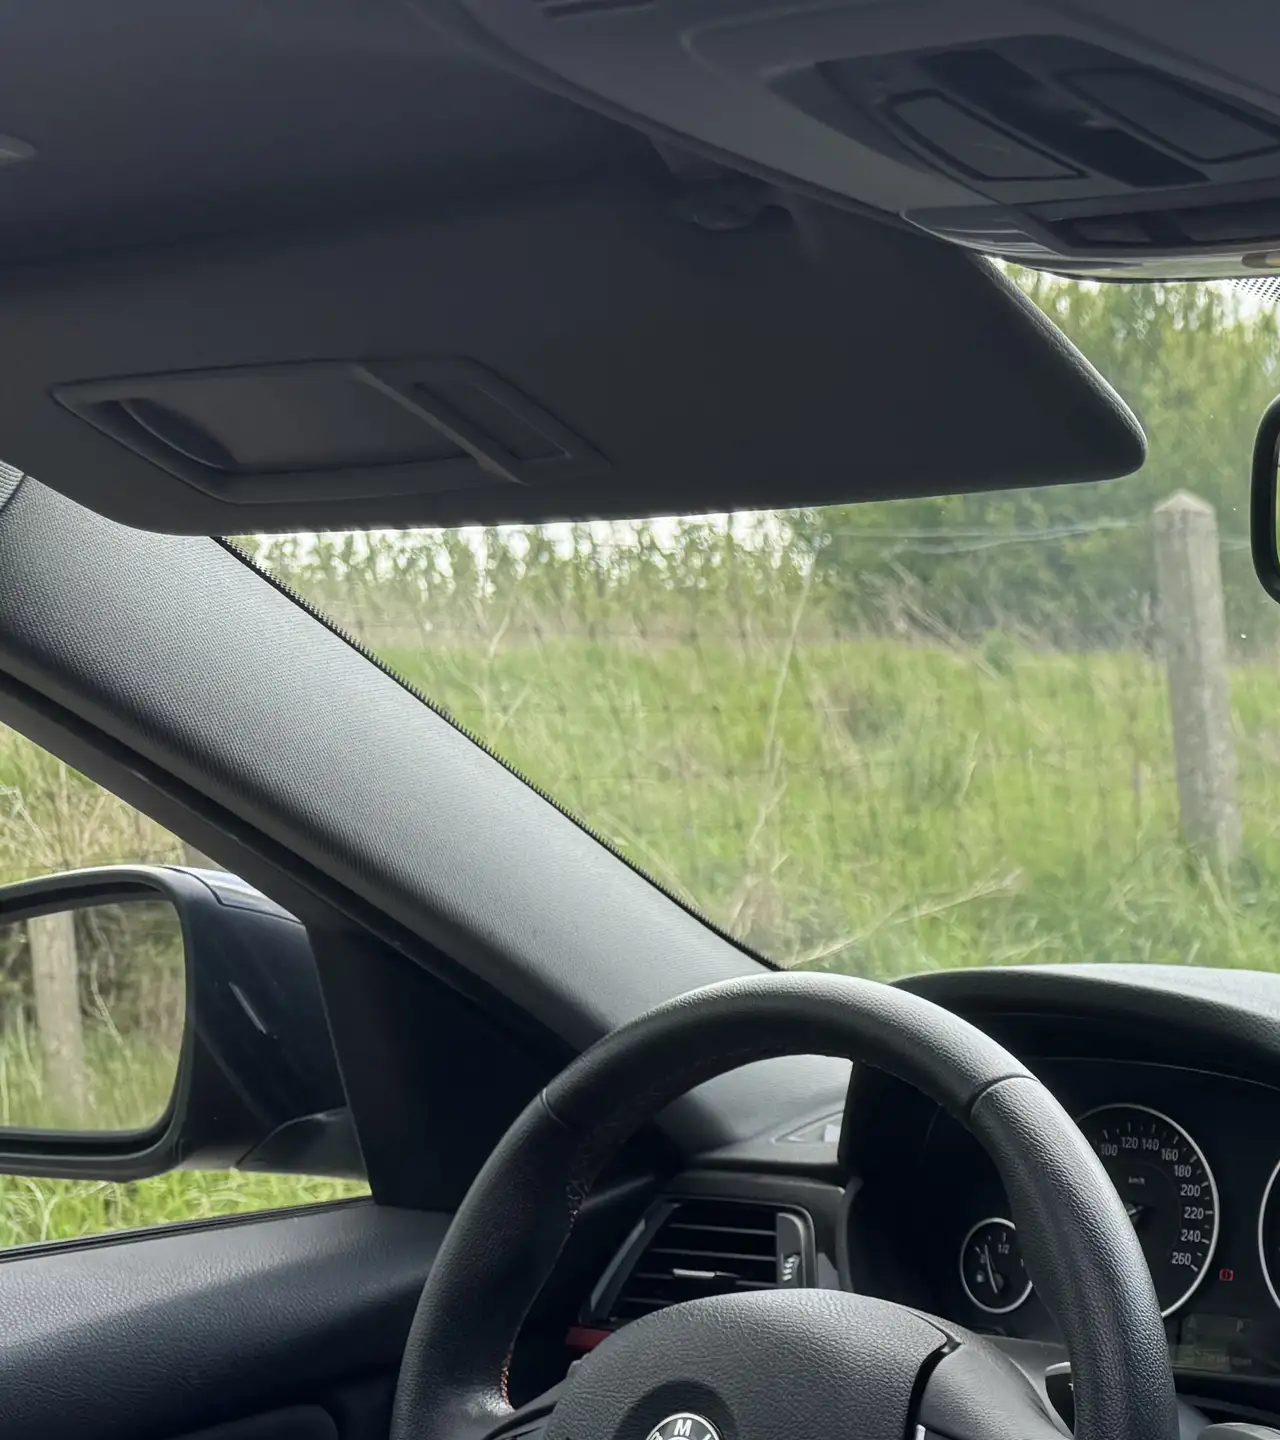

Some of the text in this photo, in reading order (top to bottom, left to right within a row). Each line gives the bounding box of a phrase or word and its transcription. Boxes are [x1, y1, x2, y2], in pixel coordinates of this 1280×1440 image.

[1121, 1137, 1138, 1149] 120
[1142, 1138, 1159, 1151] 140
[1161, 1148, 1179, 1161] 160
[1174, 1164, 1192, 1178] 180
[1180, 1183, 1201, 1197] 200
[1183, 1206, 1204, 1220] 220
[1180, 1229, 1201, 1243] 240
[1171, 1251, 1192, 1265] 260
